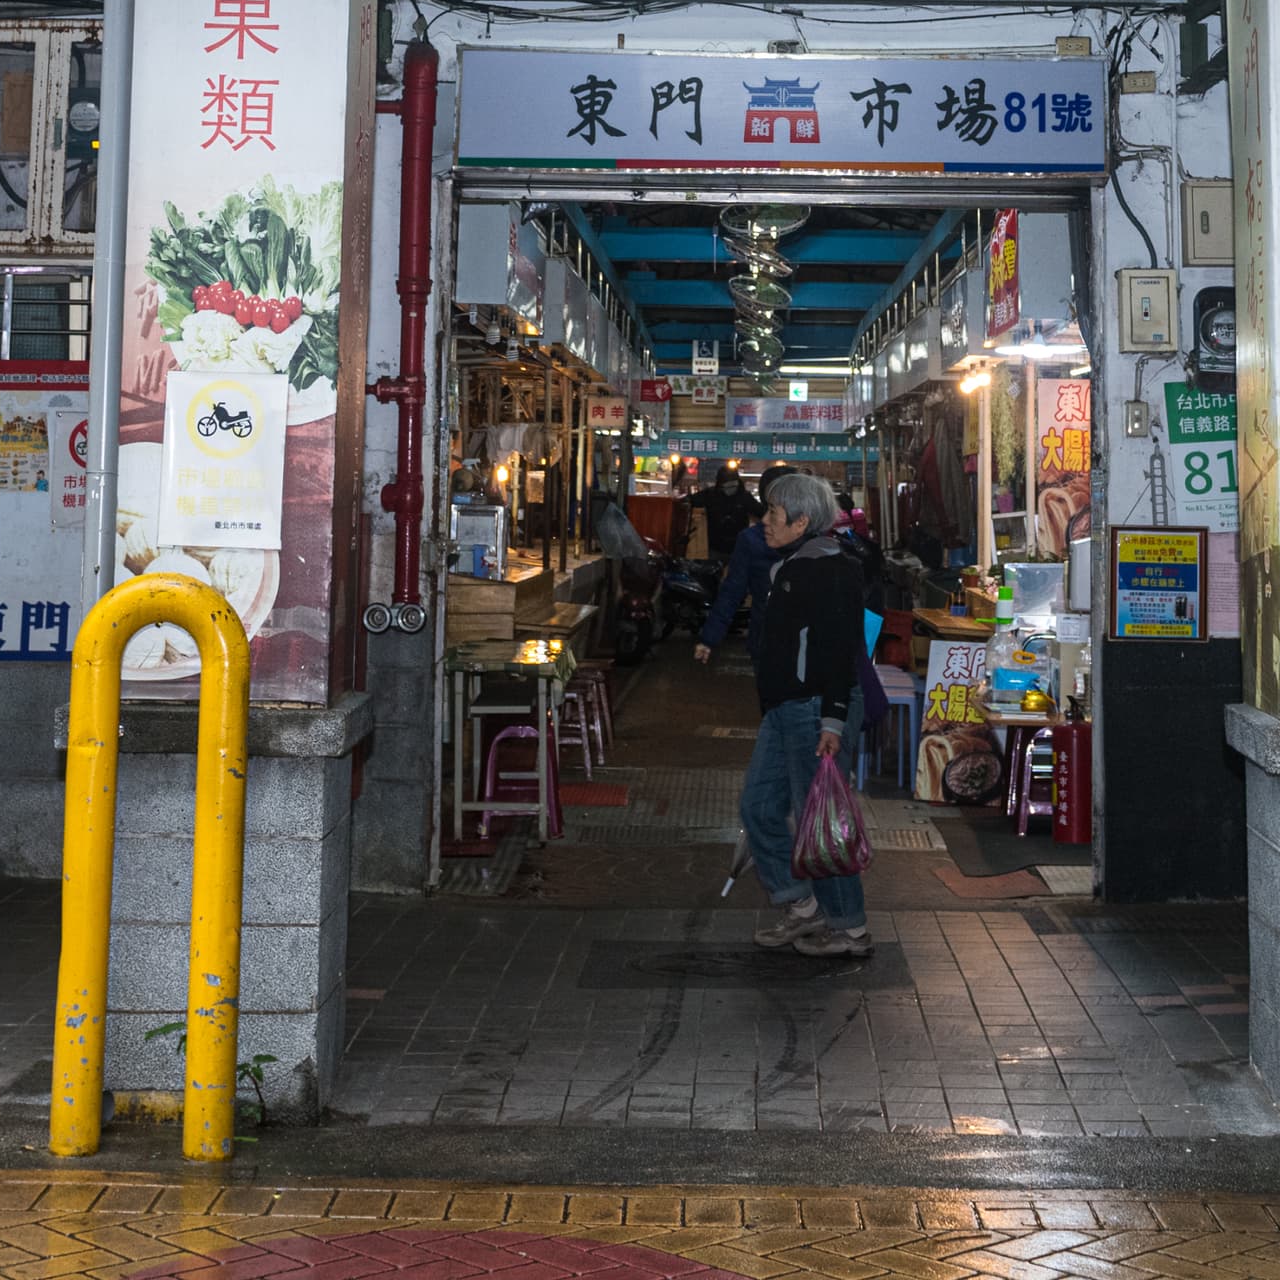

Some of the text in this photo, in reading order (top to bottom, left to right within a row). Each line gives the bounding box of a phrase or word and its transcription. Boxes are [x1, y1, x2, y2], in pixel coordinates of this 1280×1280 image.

[566, 75, 704, 146] 東門
[1003, 92, 1093, 134] 81號
[1055, 384, 1091, 422] 東
[1184, 449, 1238, 495] 81
